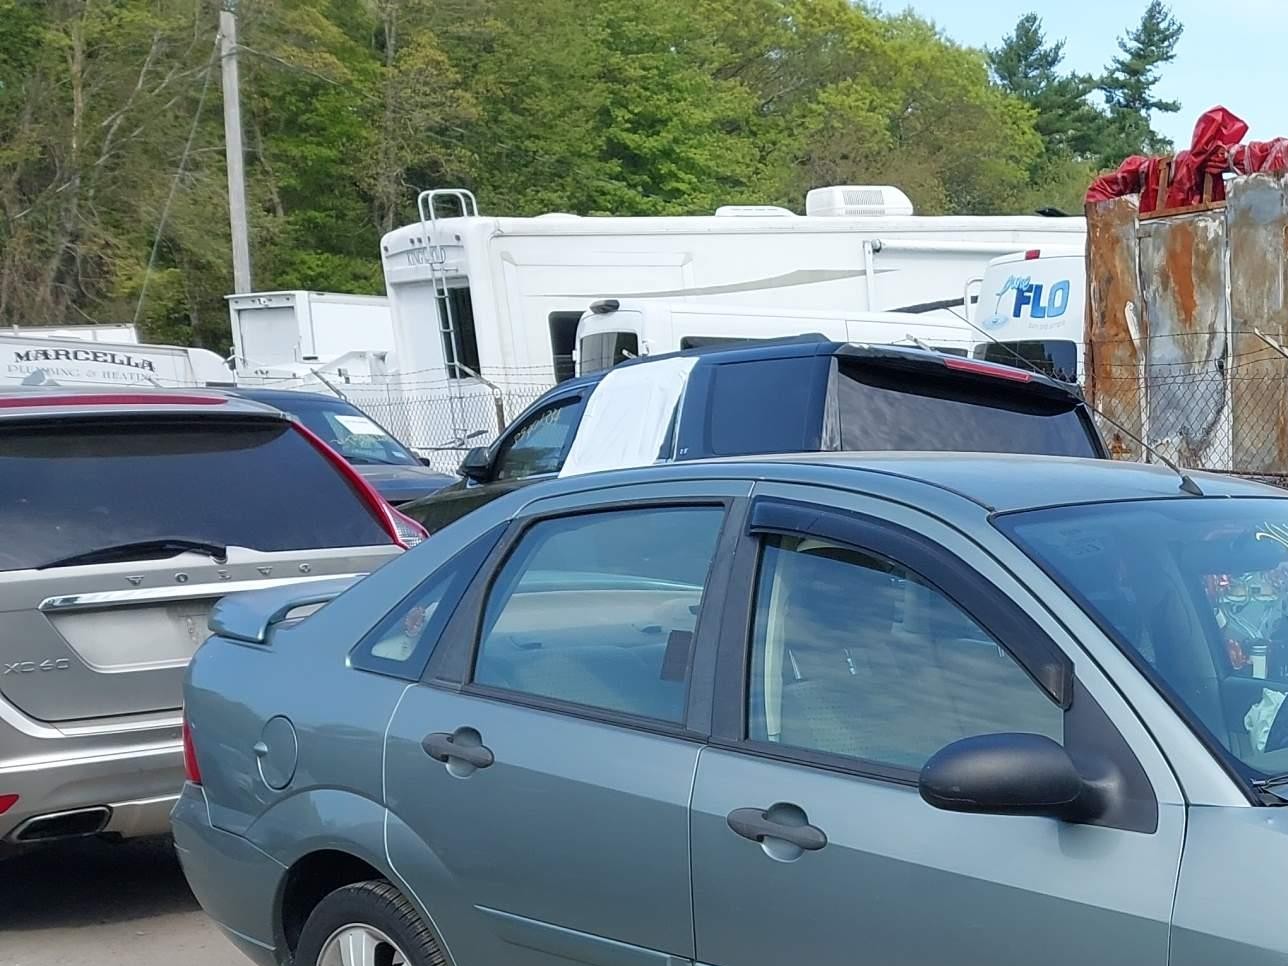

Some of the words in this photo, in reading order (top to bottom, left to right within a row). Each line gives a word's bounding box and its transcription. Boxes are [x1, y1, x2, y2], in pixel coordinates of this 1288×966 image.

[1012, 279, 1070, 318] FLO
[14, 349, 156, 372] MARCELLA
[125, 563, 312, 587] VOLVO
[3, 658, 70, 674] XC60
